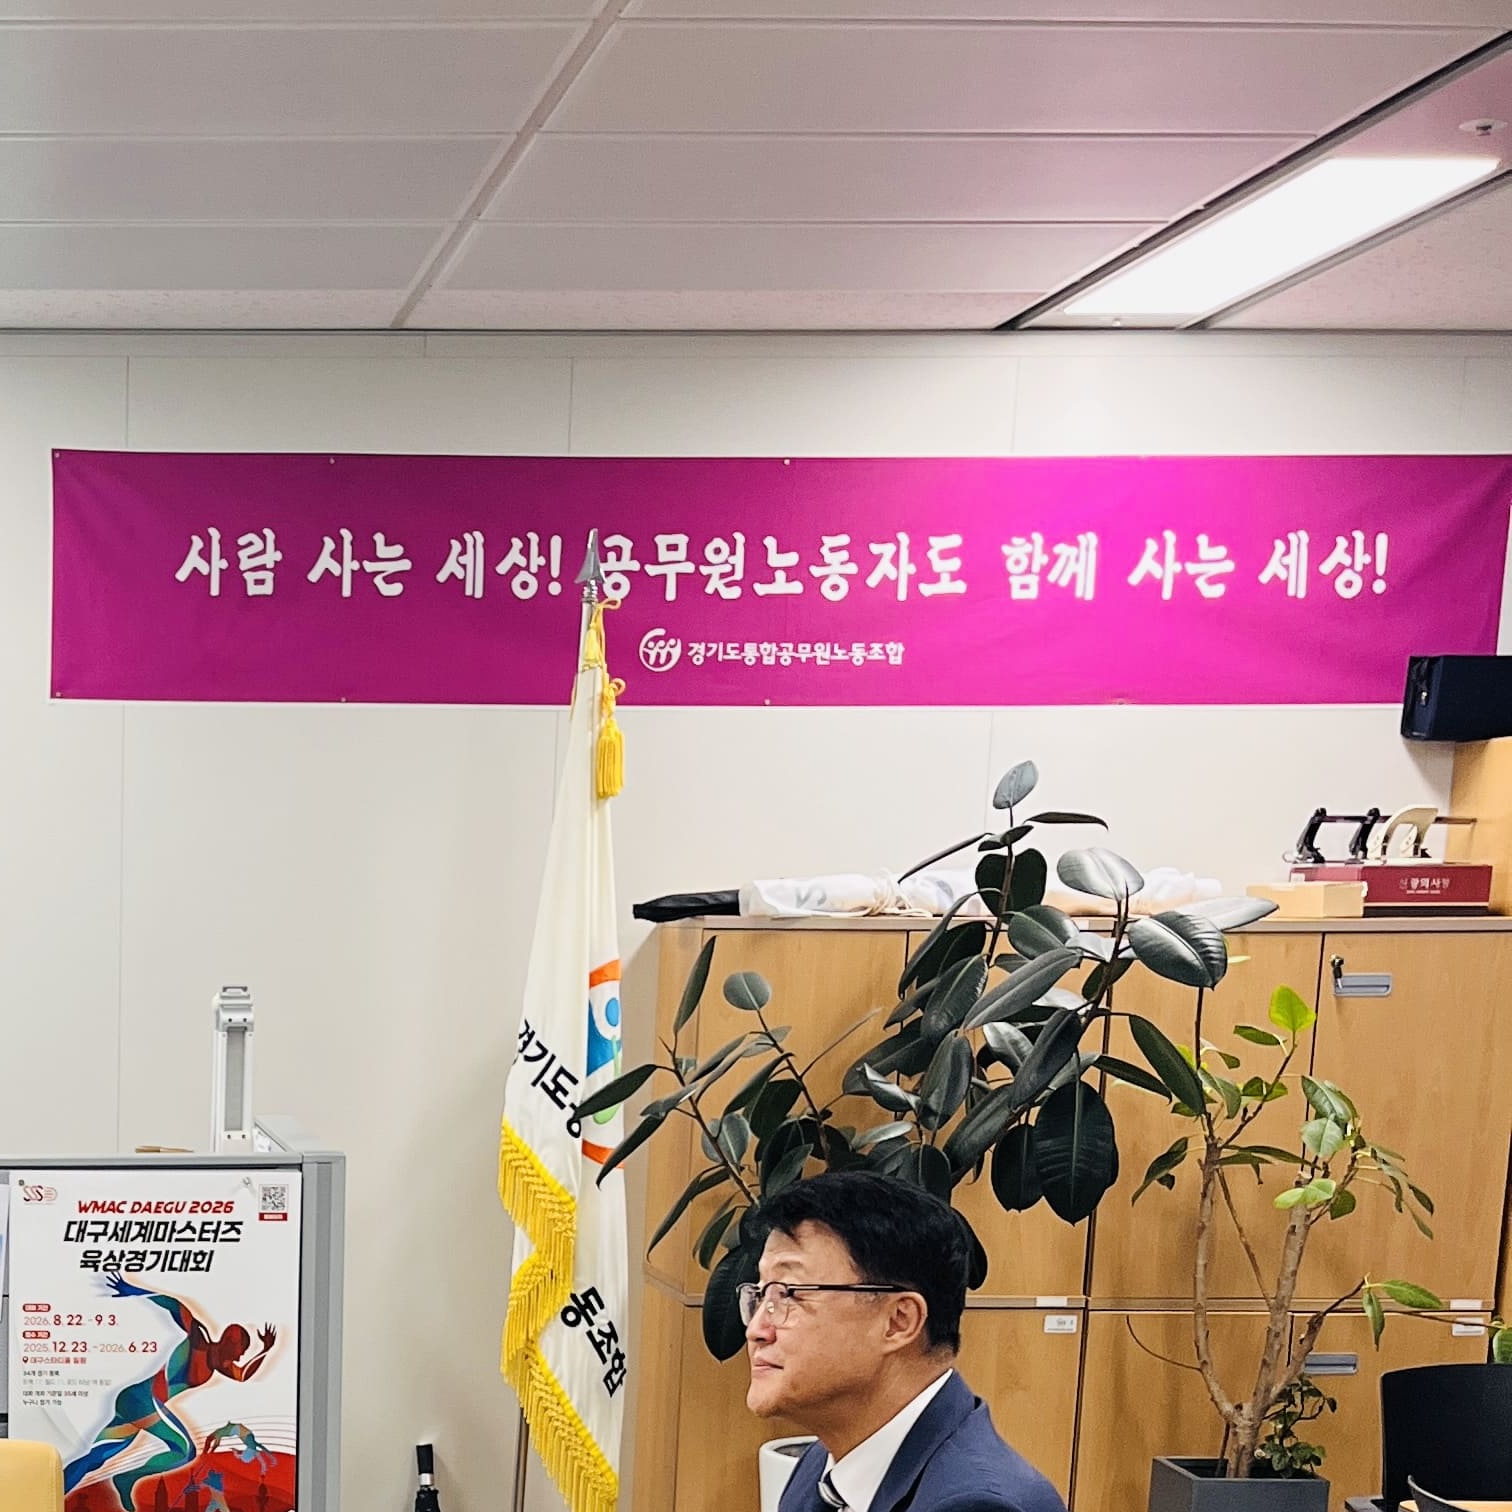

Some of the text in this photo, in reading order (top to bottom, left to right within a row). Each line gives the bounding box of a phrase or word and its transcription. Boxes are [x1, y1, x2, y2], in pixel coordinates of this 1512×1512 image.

[175, 526, 1389, 601] 사람 사는 세상! 공무원노동자도 함께 사는 세상!
[687, 641, 905, 666] 경기도통합공무원노동조합
[78, 1200, 234, 1214] WMAC DAEGU 2026
[63, 1220, 243, 1243] 대구세계마스터즈
[80, 1249, 214, 1272] 육상경기대회
